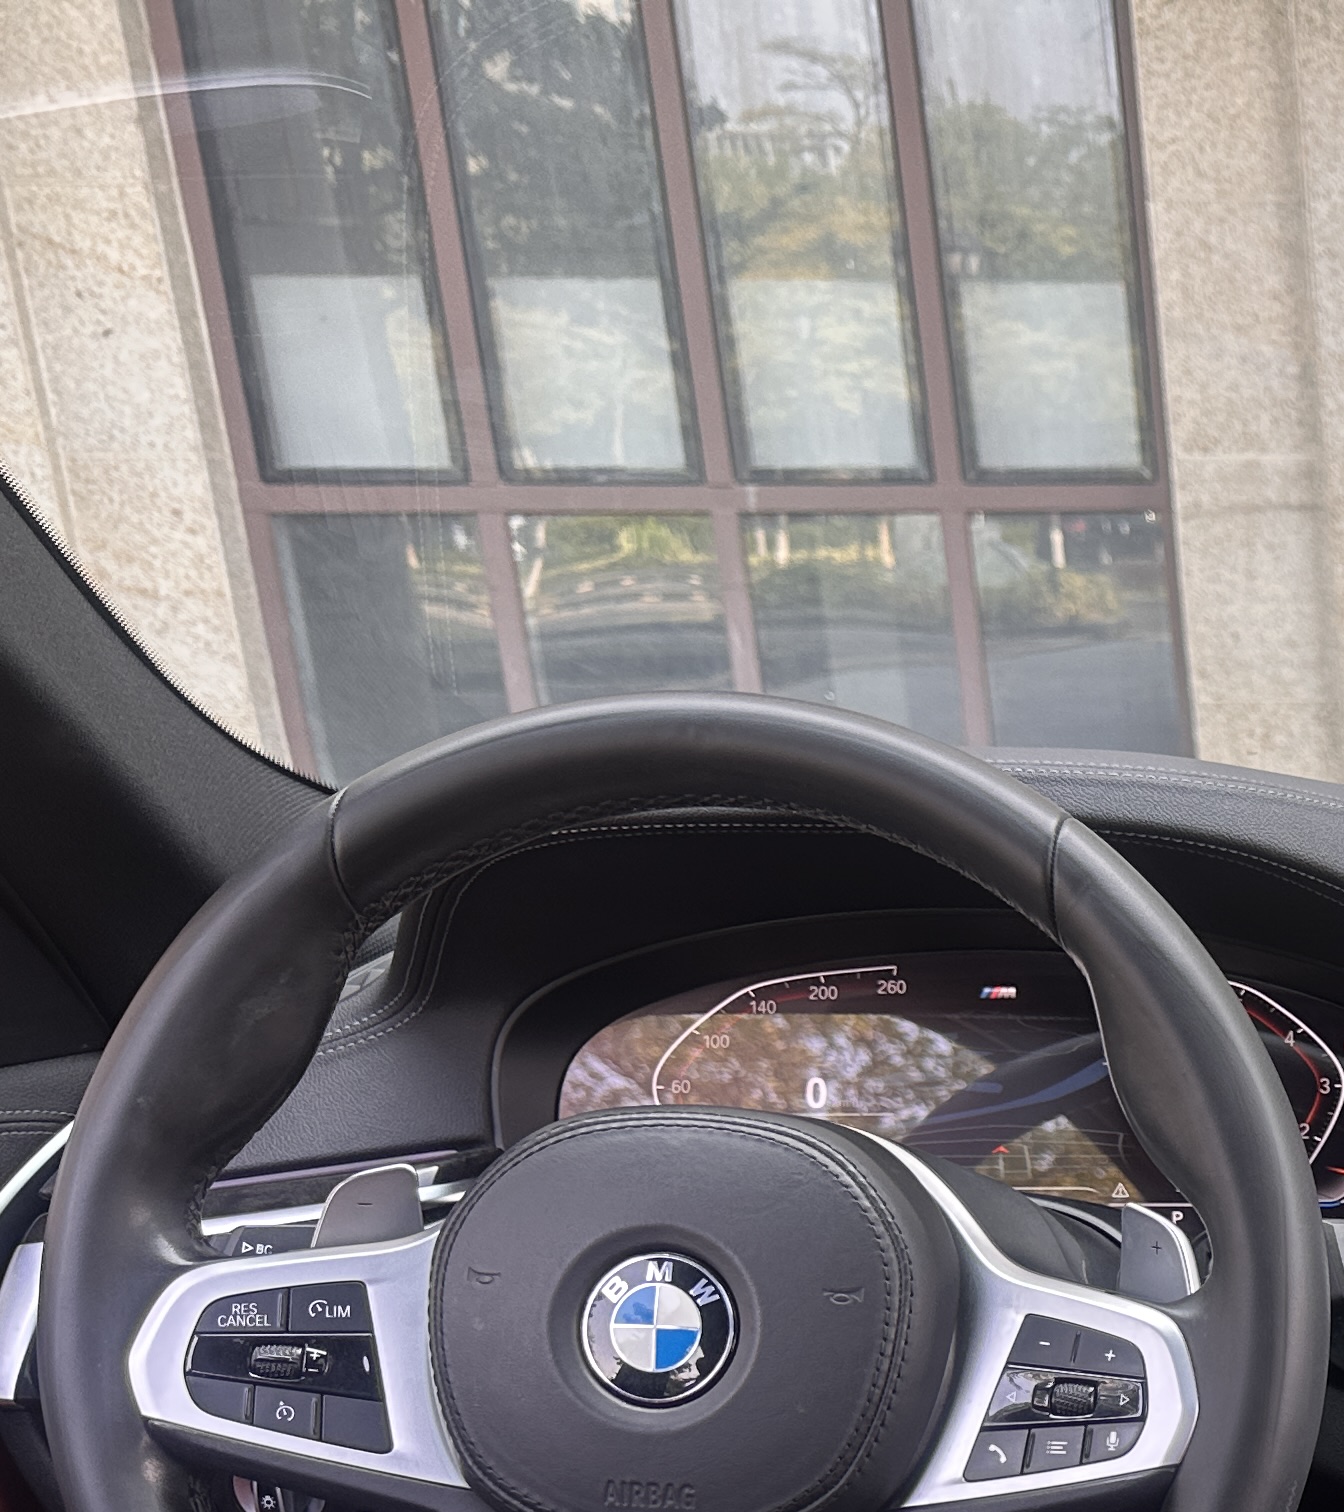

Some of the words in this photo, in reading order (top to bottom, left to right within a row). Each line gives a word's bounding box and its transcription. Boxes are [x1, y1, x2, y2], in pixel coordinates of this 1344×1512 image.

[808, 985, 839, 1001] 200
[876, 979, 907, 996] 260
[749, 1000, 777, 1016] 140
[703, 1034, 731, 1050] 100
[1284, 1030, 1296, 1047] 4
[671, 1079, 692, 1095] 60
[806, 1077, 828, 1109] 0
[1319, 1077, 1331, 1095] 3
[1300, 1122, 1310, 1140] 2
[1172, 1210, 1184, 1225] P
[601, 1260, 721, 1307] BMW
[231, 1302, 258, 1315] RES
[325, 1305, 351, 1318] LIM
[217, 1315, 272, 1328] CANCEL
[603, 1479, 697, 1510] AIRBAG
